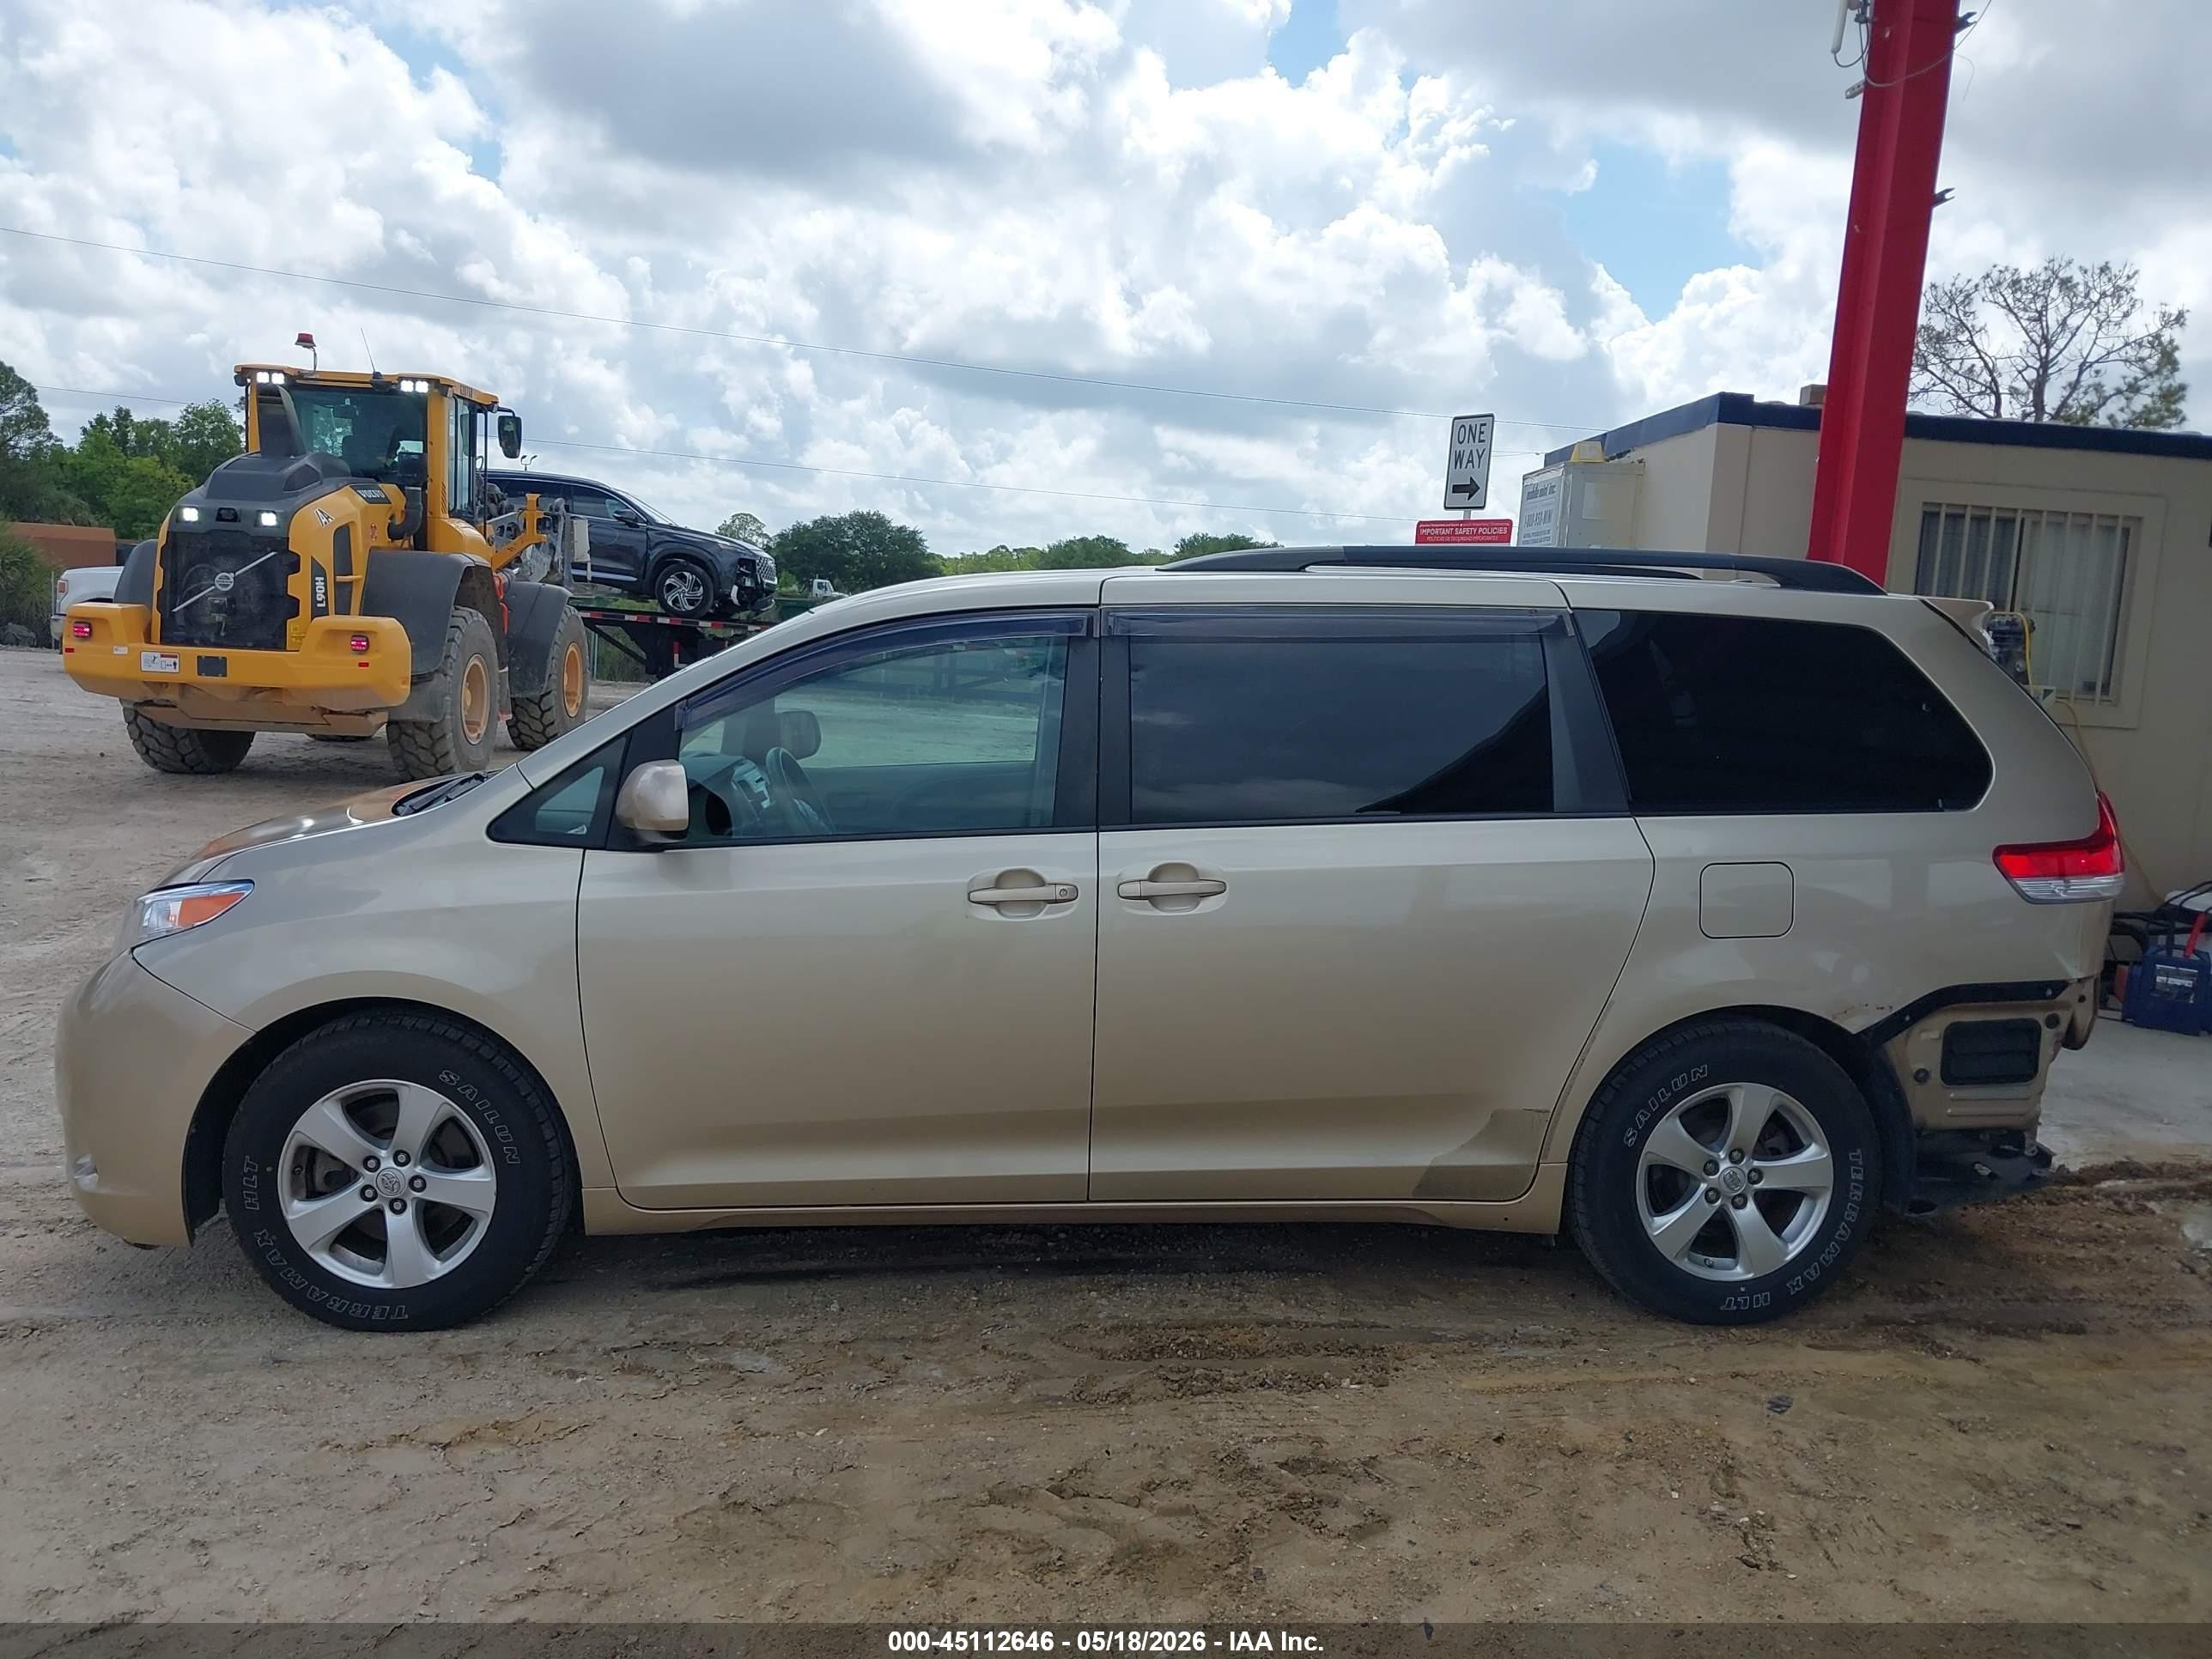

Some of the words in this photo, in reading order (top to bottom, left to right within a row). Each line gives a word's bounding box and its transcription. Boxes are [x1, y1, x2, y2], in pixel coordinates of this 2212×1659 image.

[1457, 422, 1486, 445] ONE
[1454, 447, 1486, 470] WAY
[356, 489, 386, 499] VOLVO
[1419, 527, 1454, 536] IMPORTANT
[1455, 526, 1478, 535] SAFETY
[1478, 526, 1508, 535] POLICIES
[314, 576, 326, 608] L90H
[438, 1069, 522, 1165] SAILUN
[1623, 1064, 1710, 1147] SAILUN
[241, 1155, 261, 1211] HLT
[1786, 1148, 1865, 1296] TERRAMAX
[253, 1228, 409, 1321] TERRAMAX
[1720, 1291, 1771, 1311] HLT
